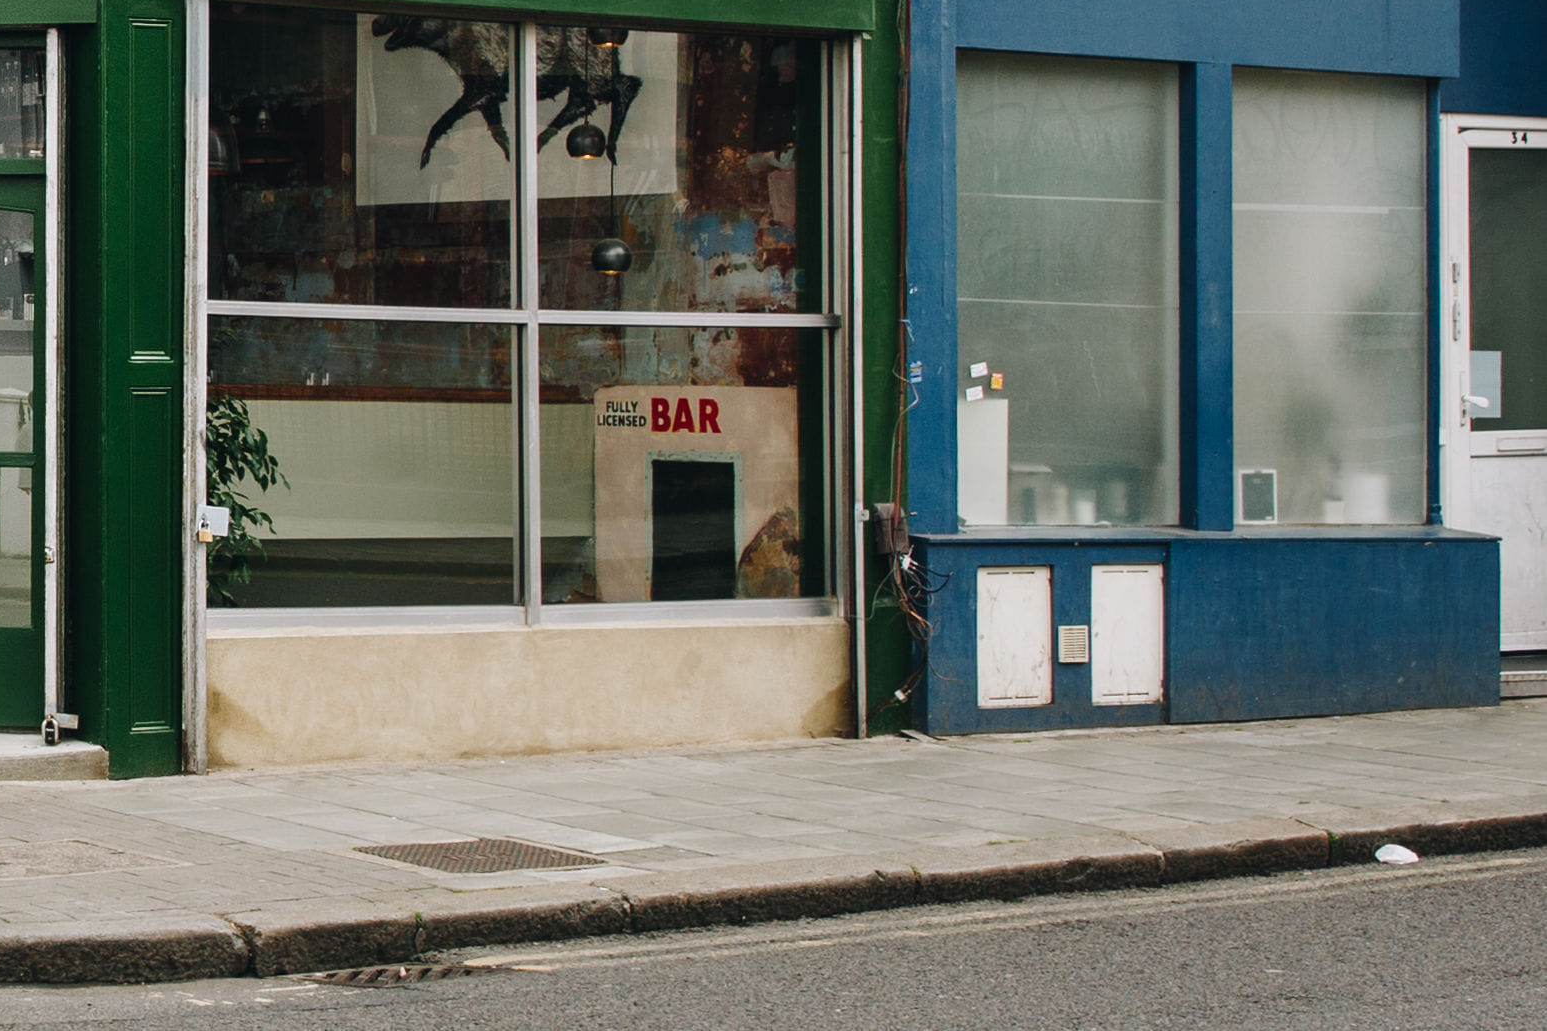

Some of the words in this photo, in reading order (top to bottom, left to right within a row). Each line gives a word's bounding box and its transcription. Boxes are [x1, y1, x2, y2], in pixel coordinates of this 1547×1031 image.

[606, 401, 639, 413] FULLY
[597, 414, 647, 427] LICENSED
[651, 397, 722, 434] BAR
